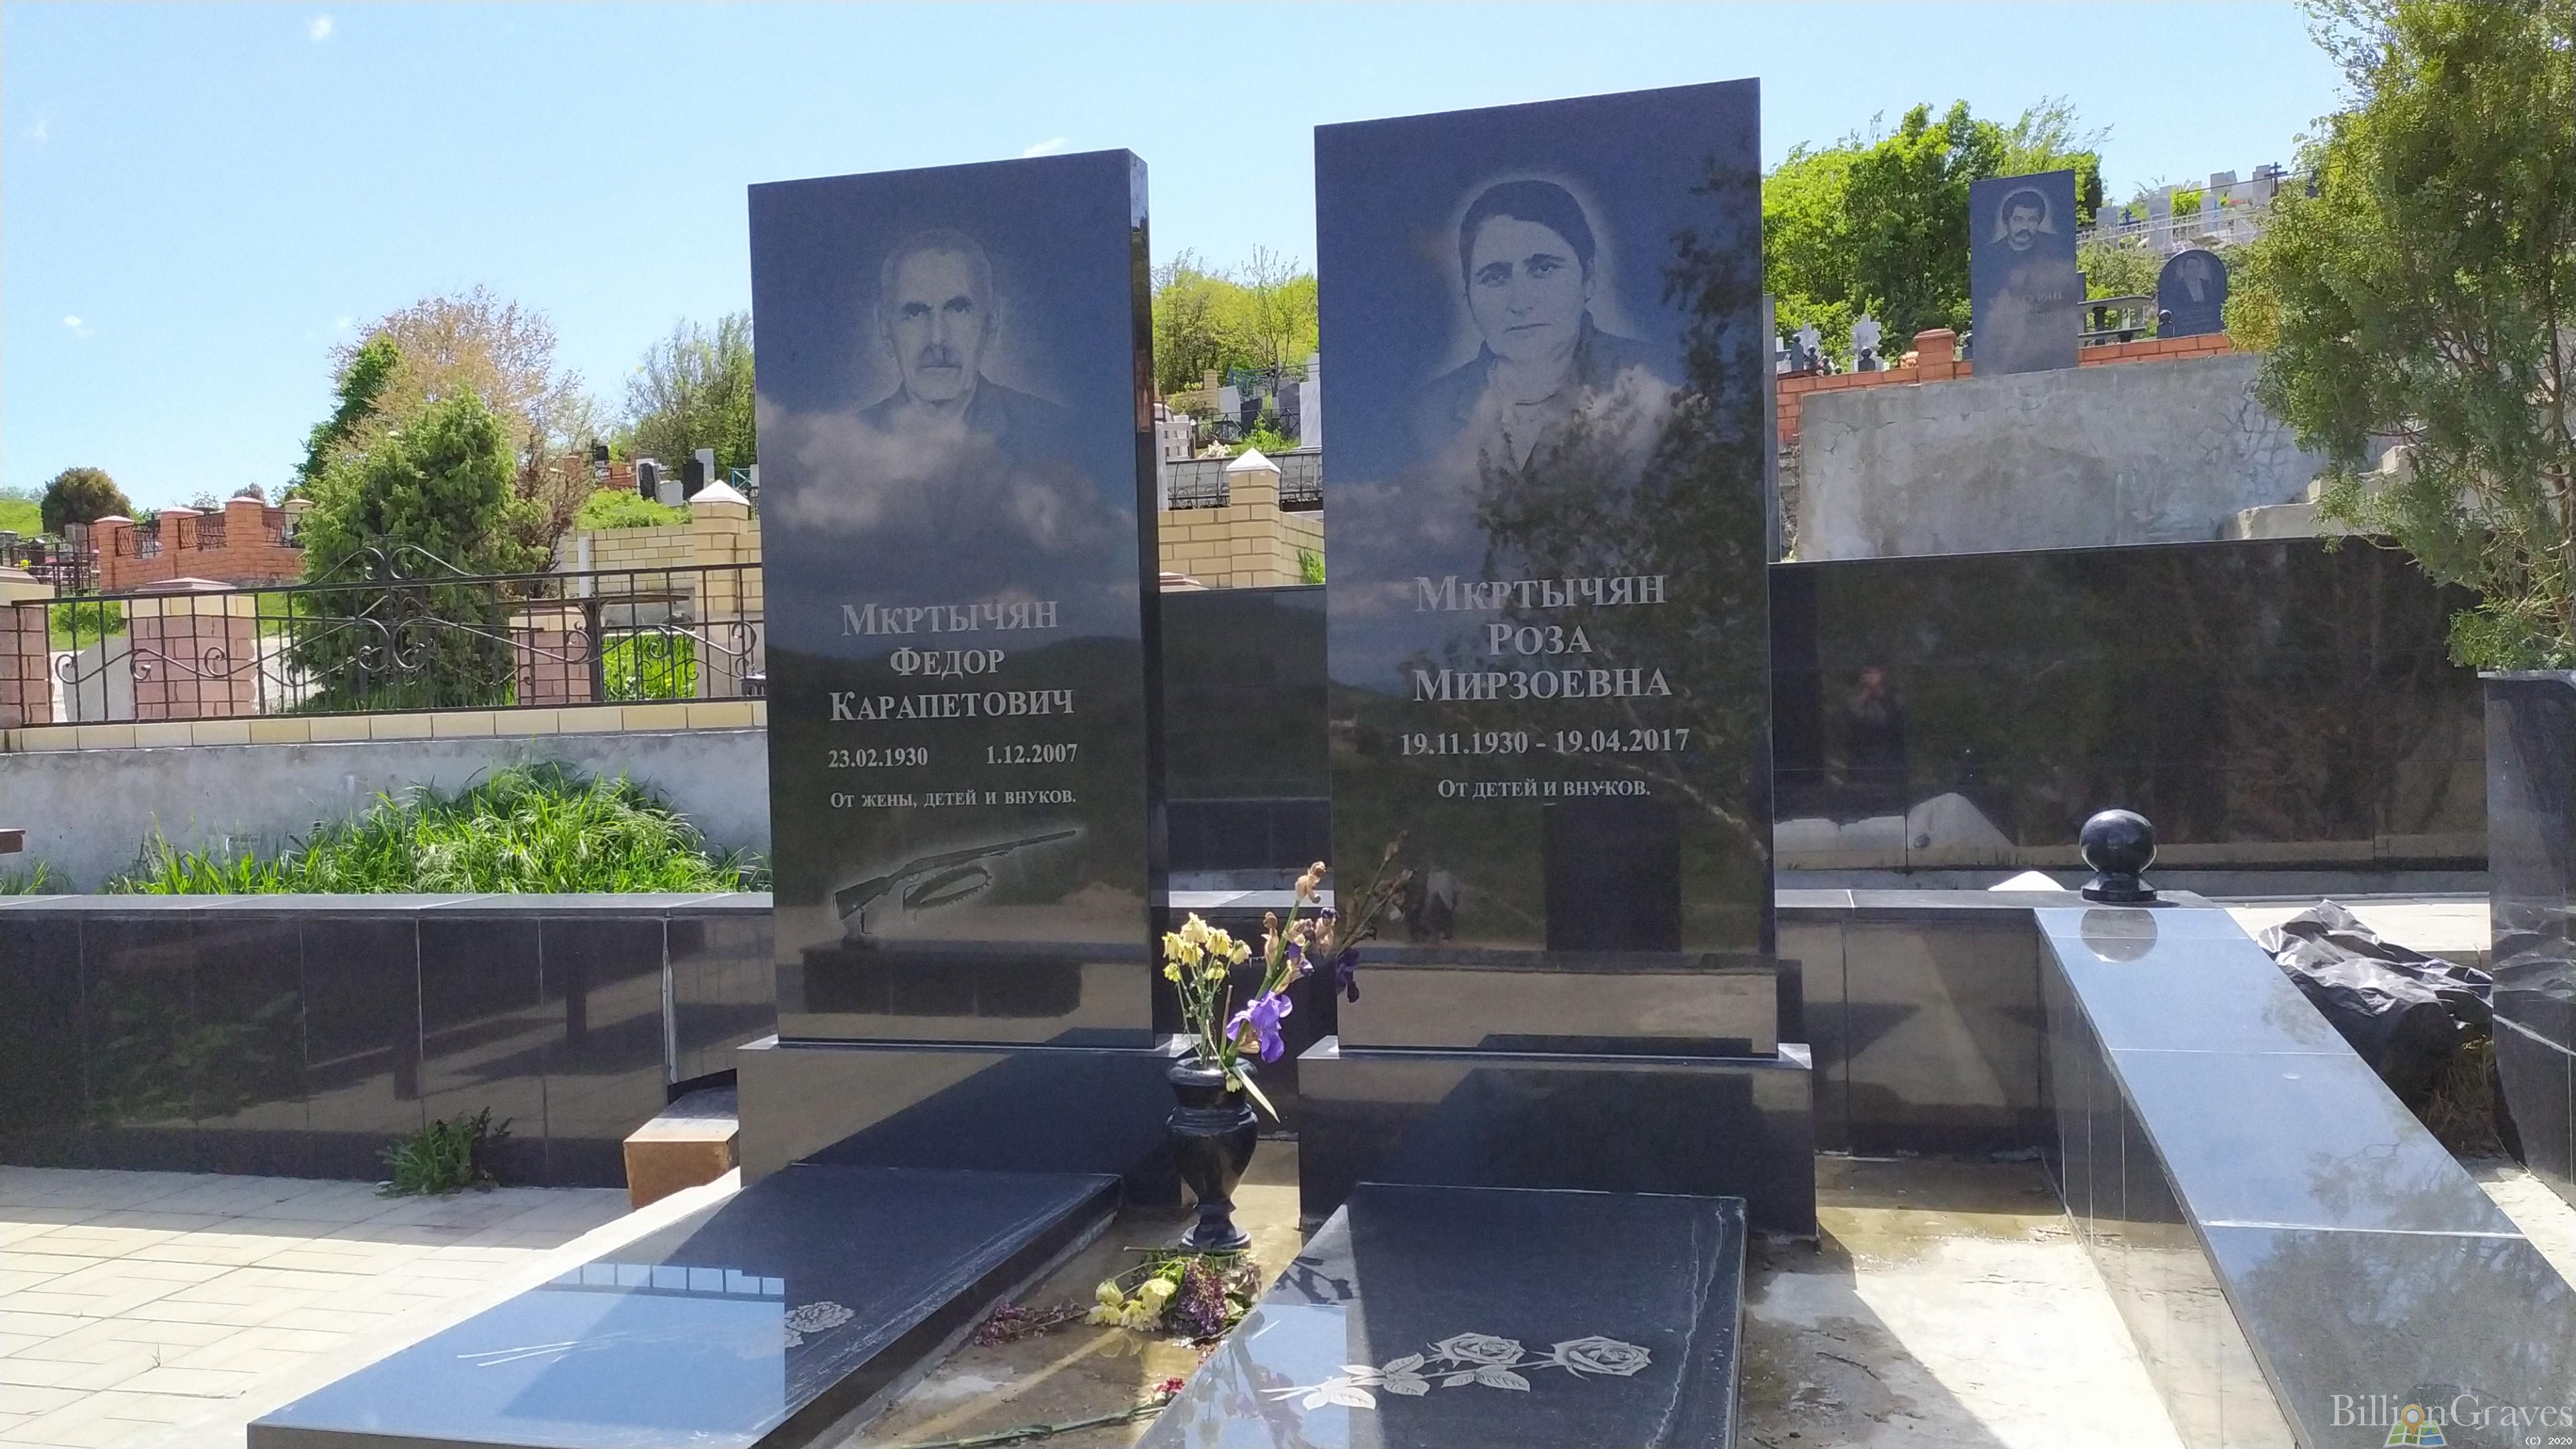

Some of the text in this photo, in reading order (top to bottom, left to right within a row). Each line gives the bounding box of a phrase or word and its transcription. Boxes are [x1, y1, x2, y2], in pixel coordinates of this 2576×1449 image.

[1487, 623, 1593, 655] РОЗА
[890, 647, 1005, 680] ФЕДОР
[828, 743, 1079, 767] 23.02.1930 1.12.2007
[1401, 732, 1529, 755] 19.11.1930
[1556, 729, 1690, 753] 19.04.2017
